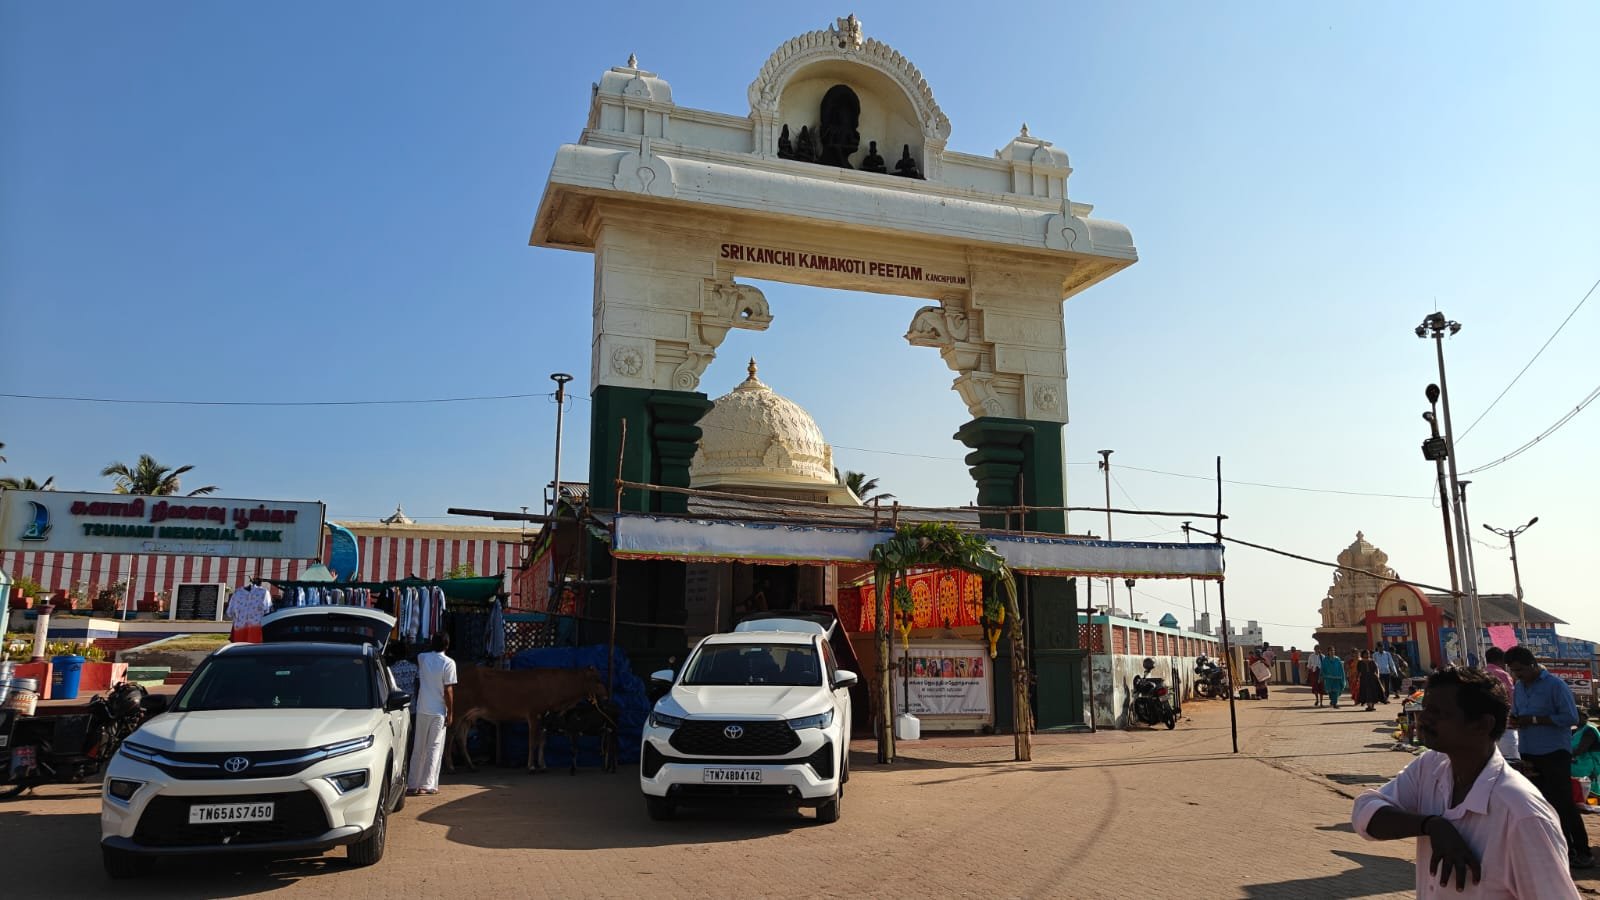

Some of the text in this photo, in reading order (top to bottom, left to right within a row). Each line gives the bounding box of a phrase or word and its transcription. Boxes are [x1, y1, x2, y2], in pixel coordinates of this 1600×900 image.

[721, 243, 966, 285] SRI KANCHI KAMAKOTI PEETAM KANCHIPURAM
[232, 504, 298, 529] பூங்கா
[83, 523, 283, 542] TSUNAMI MEMORIAL PARK
[710, 770, 760, 781] TN74BD4142
[199, 806, 272, 820] TN65AS7450
